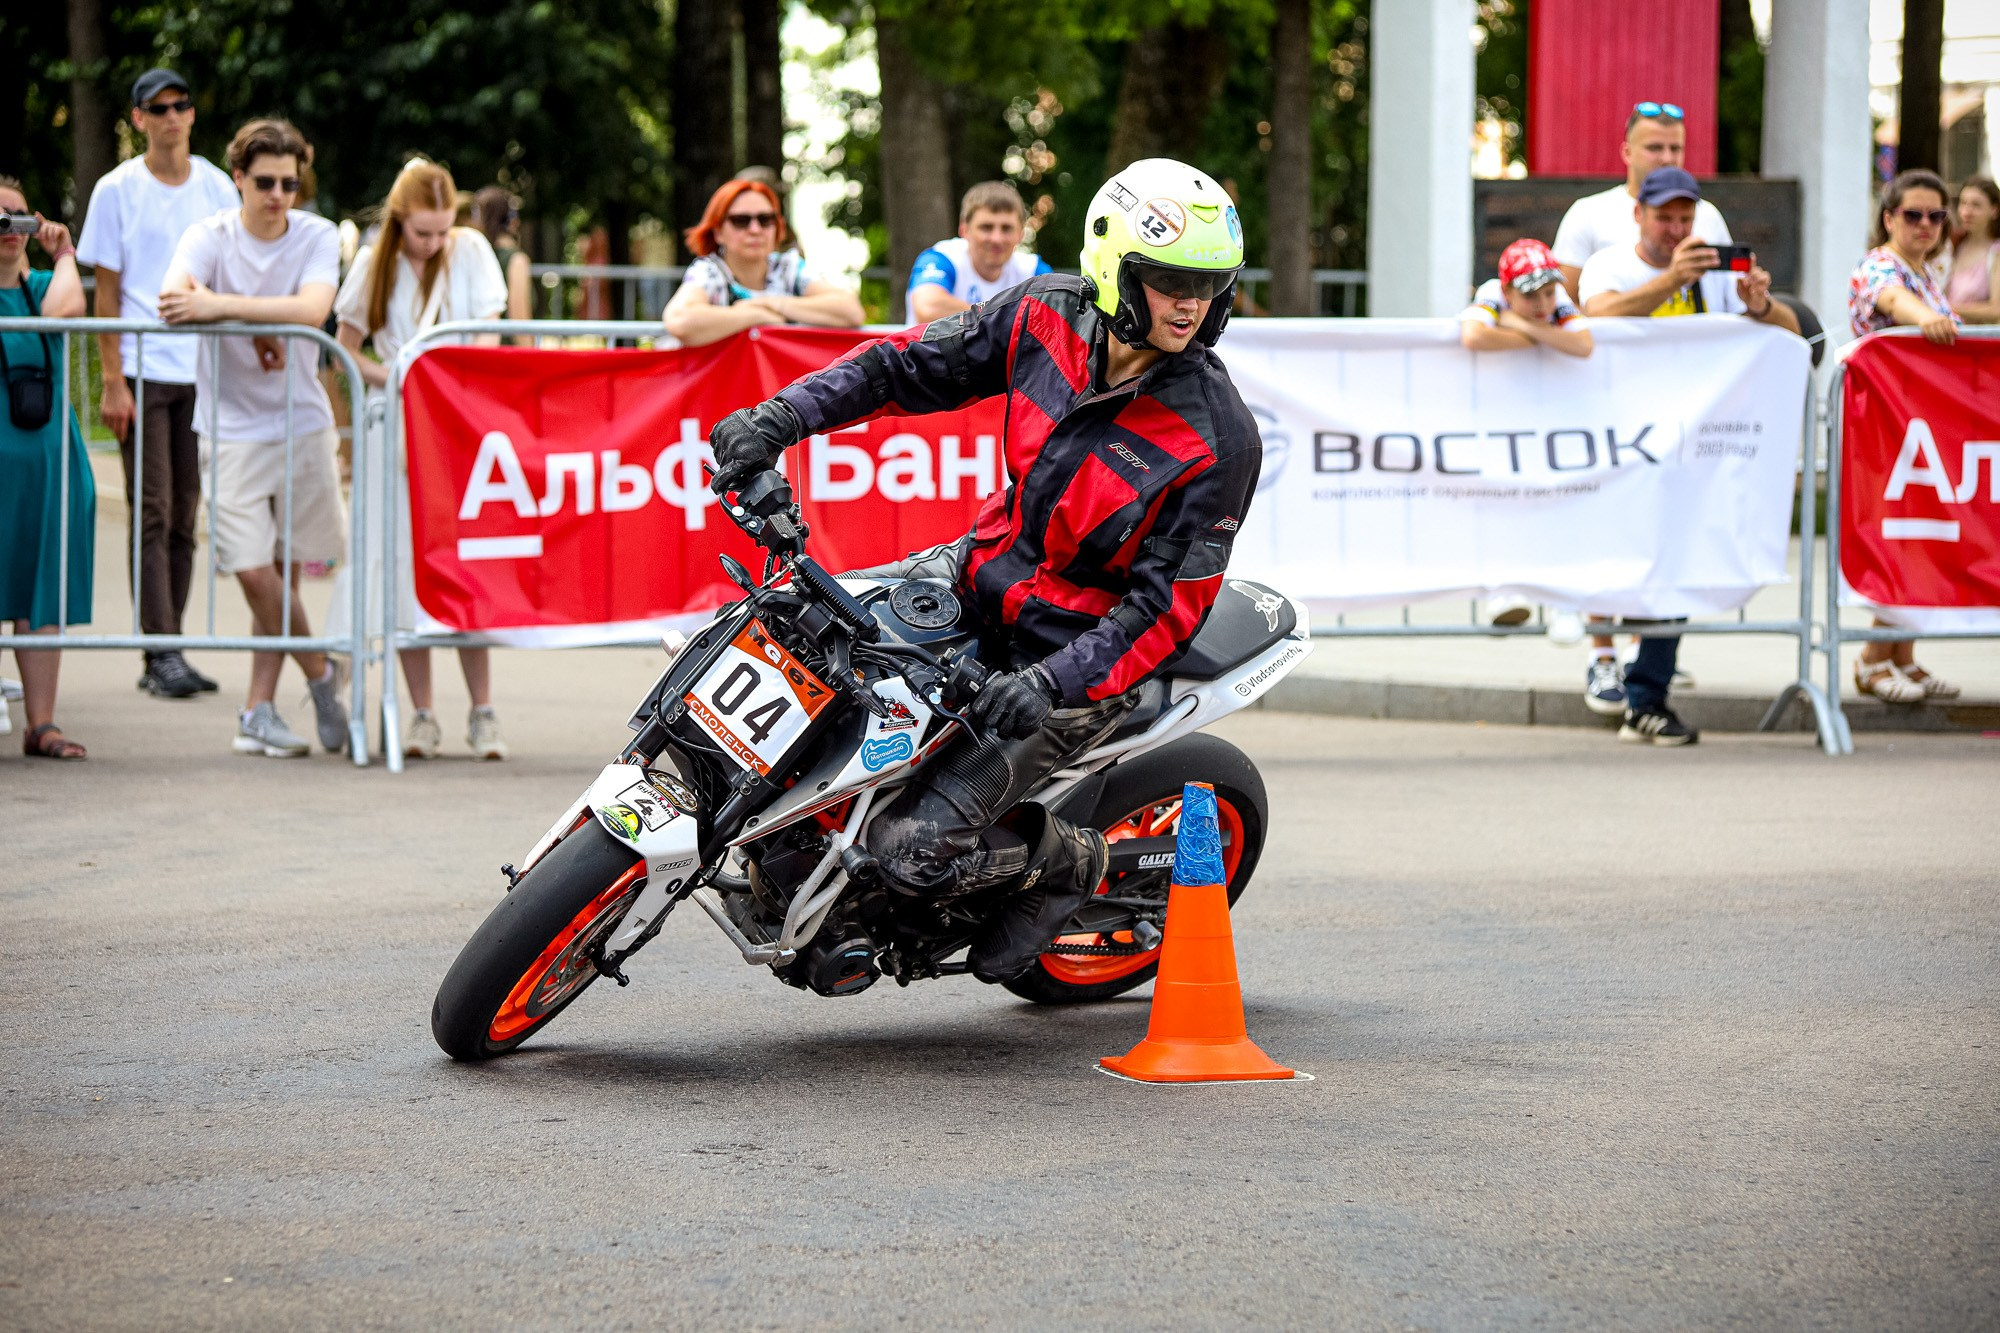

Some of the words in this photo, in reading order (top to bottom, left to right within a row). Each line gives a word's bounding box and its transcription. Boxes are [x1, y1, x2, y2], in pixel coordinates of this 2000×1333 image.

[1141, 215, 1167, 239] 12
[1108, 443, 1150, 470] RST
[1313, 425, 1659, 475] ВОСТОК
[459, 418, 787, 531] Альф
[809, 424, 1012, 501] Бан
[1214, 518, 1239, 532] RS
[711, 662, 793, 746] 04
[689, 699, 765, 770] СМОЛЕНСК
[634, 798, 656, 817] 4
[1138, 852, 1176, 866] GALFE
